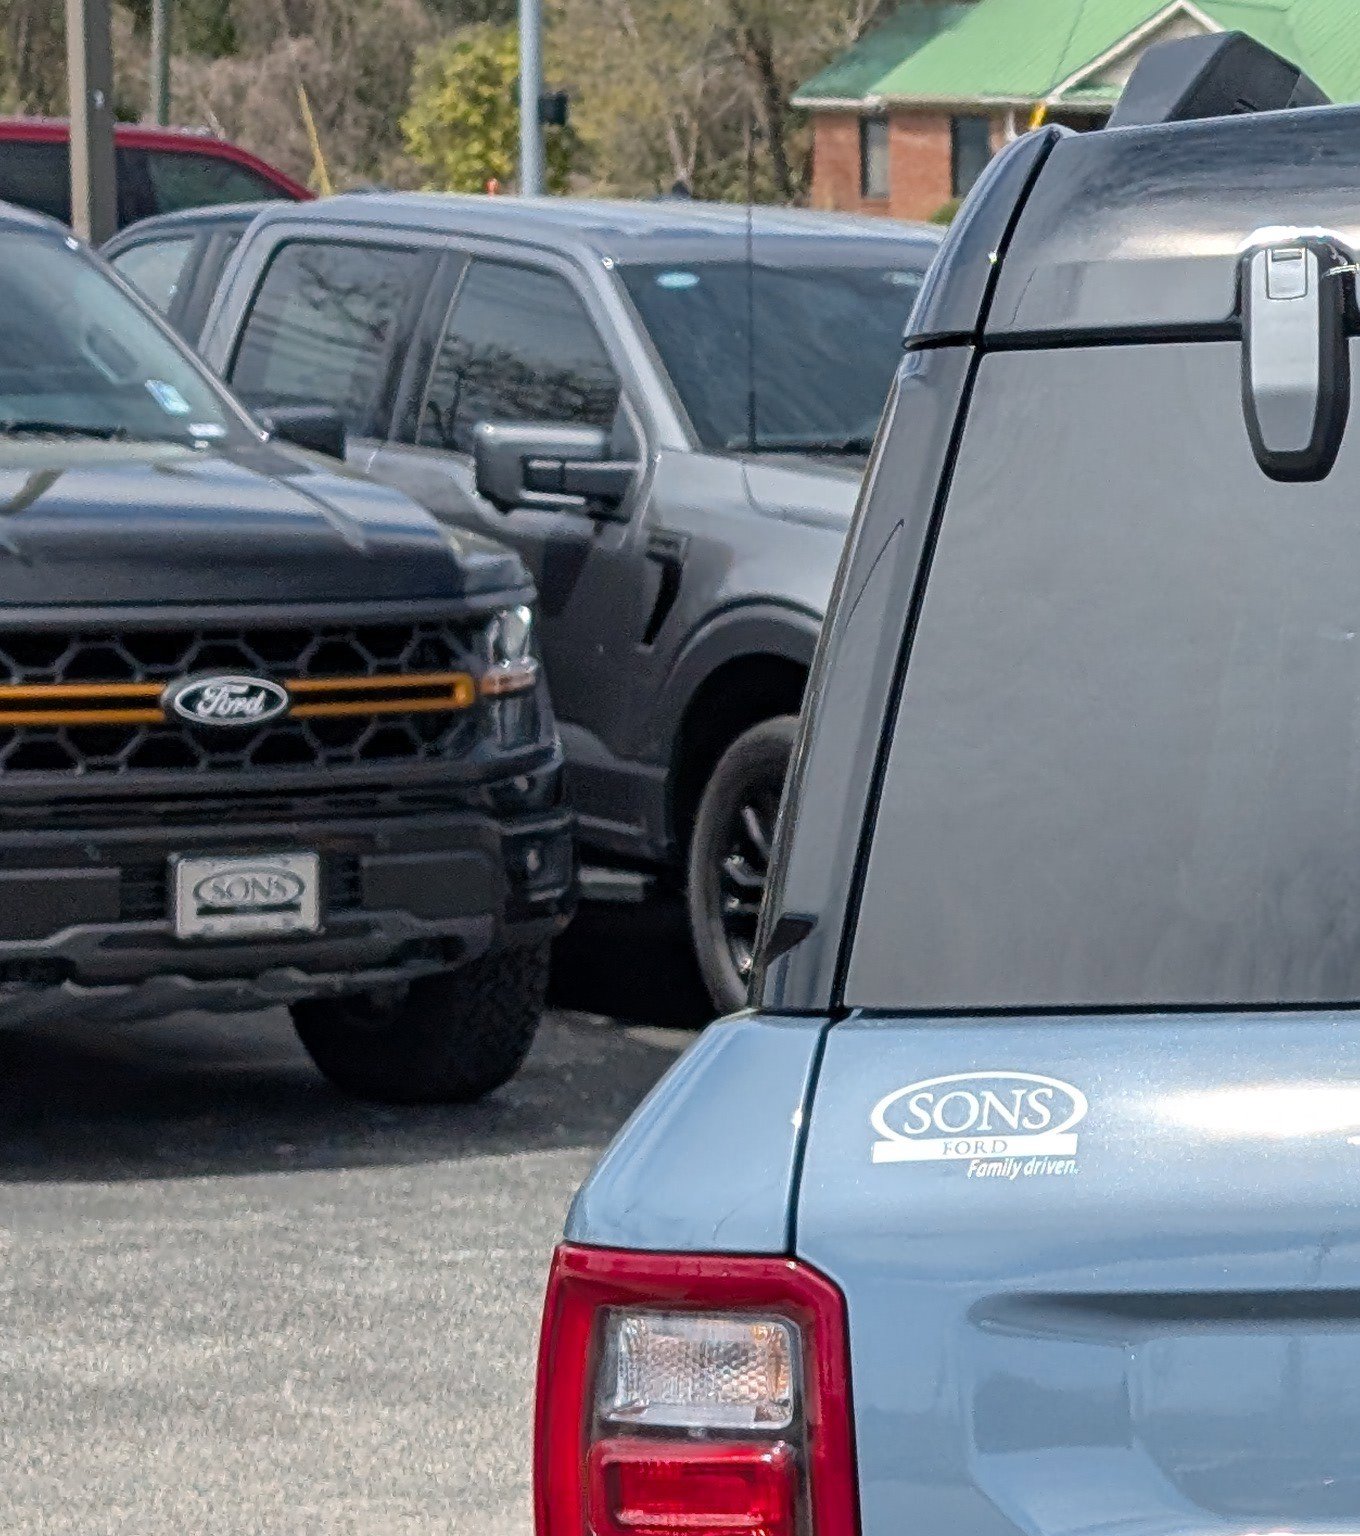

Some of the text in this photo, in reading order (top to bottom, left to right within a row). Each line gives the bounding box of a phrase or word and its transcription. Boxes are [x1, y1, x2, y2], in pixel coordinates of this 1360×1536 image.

[198, 684, 267, 717] Ford
[904, 1088, 1053, 1134] SONS
[942, 1140, 1009, 1156] FORD
[967, 1158, 1023, 1180] Family
